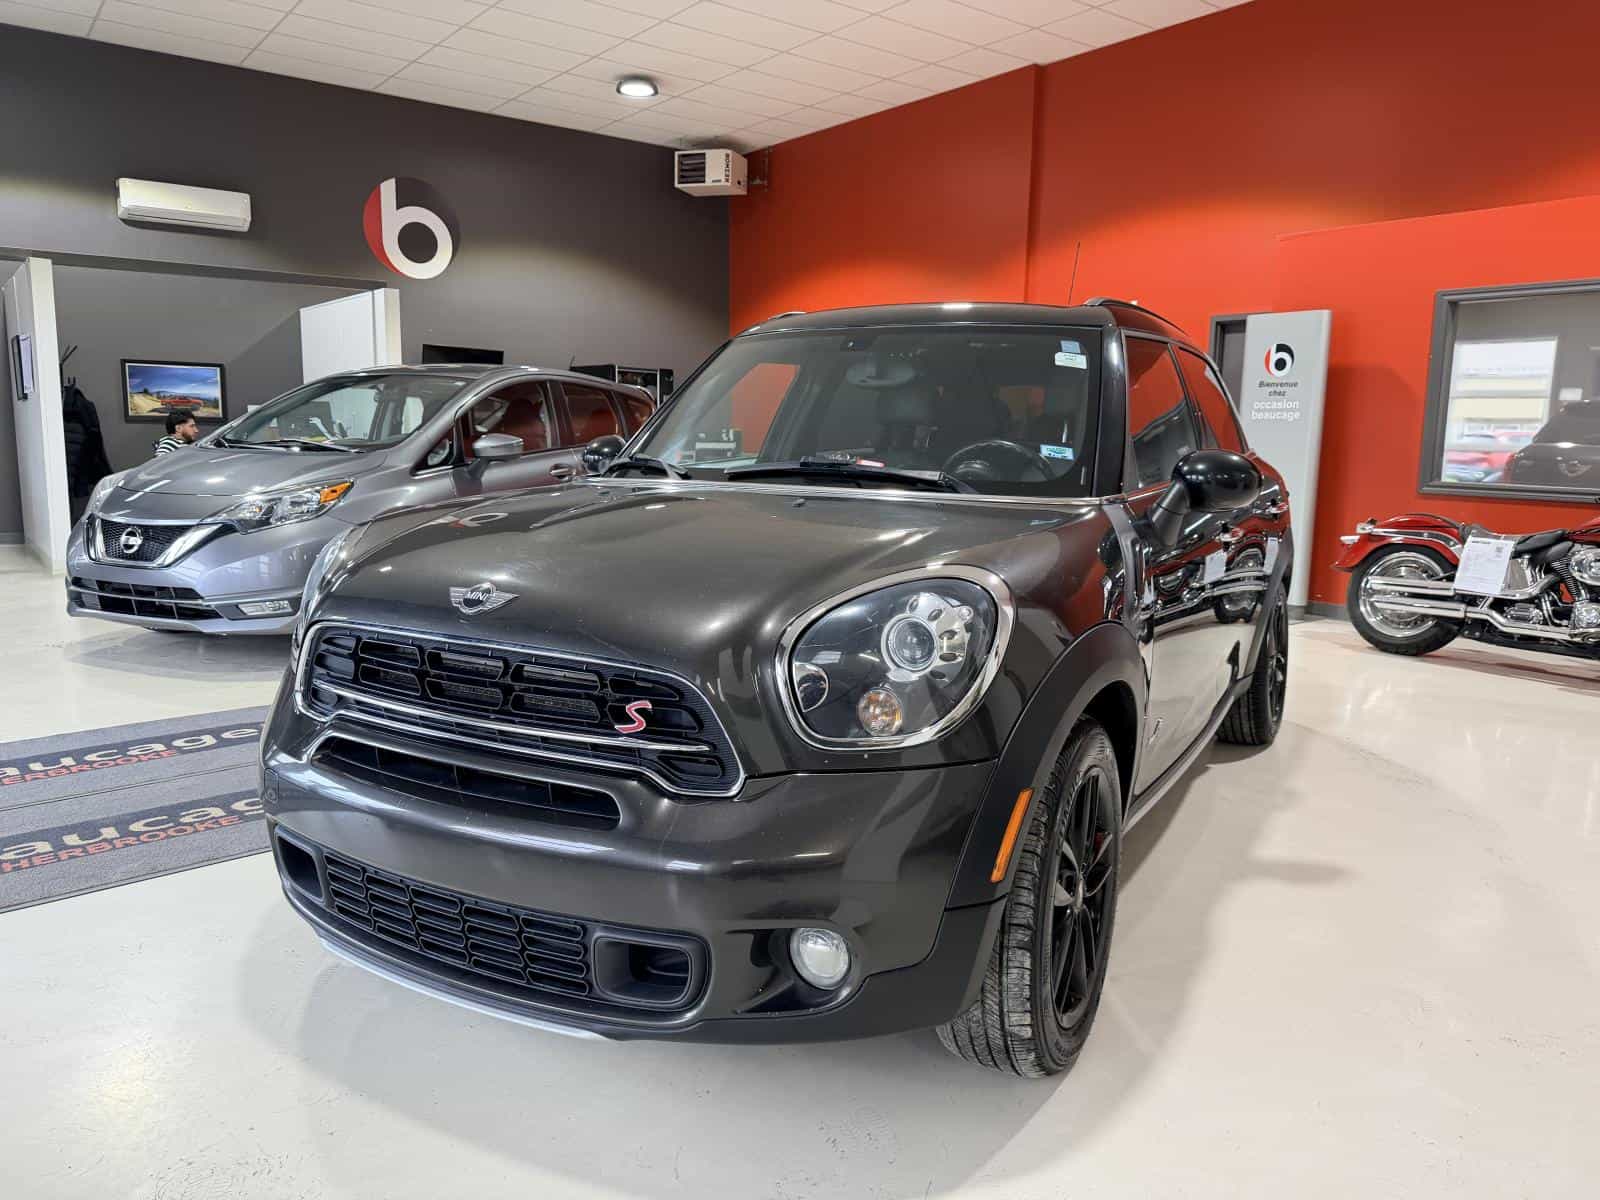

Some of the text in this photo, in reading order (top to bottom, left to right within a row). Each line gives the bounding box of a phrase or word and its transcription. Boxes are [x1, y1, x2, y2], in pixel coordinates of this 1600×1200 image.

[380, 177, 454, 280] b
[1267, 344, 1293, 377] b
[1258, 381, 1299, 389] Bienvenue
[1253, 400, 1300, 409] occasion
[1251, 411, 1301, 422] beaucage
[466, 591, 490, 601] MINI
[614, 700, 653, 734] S
